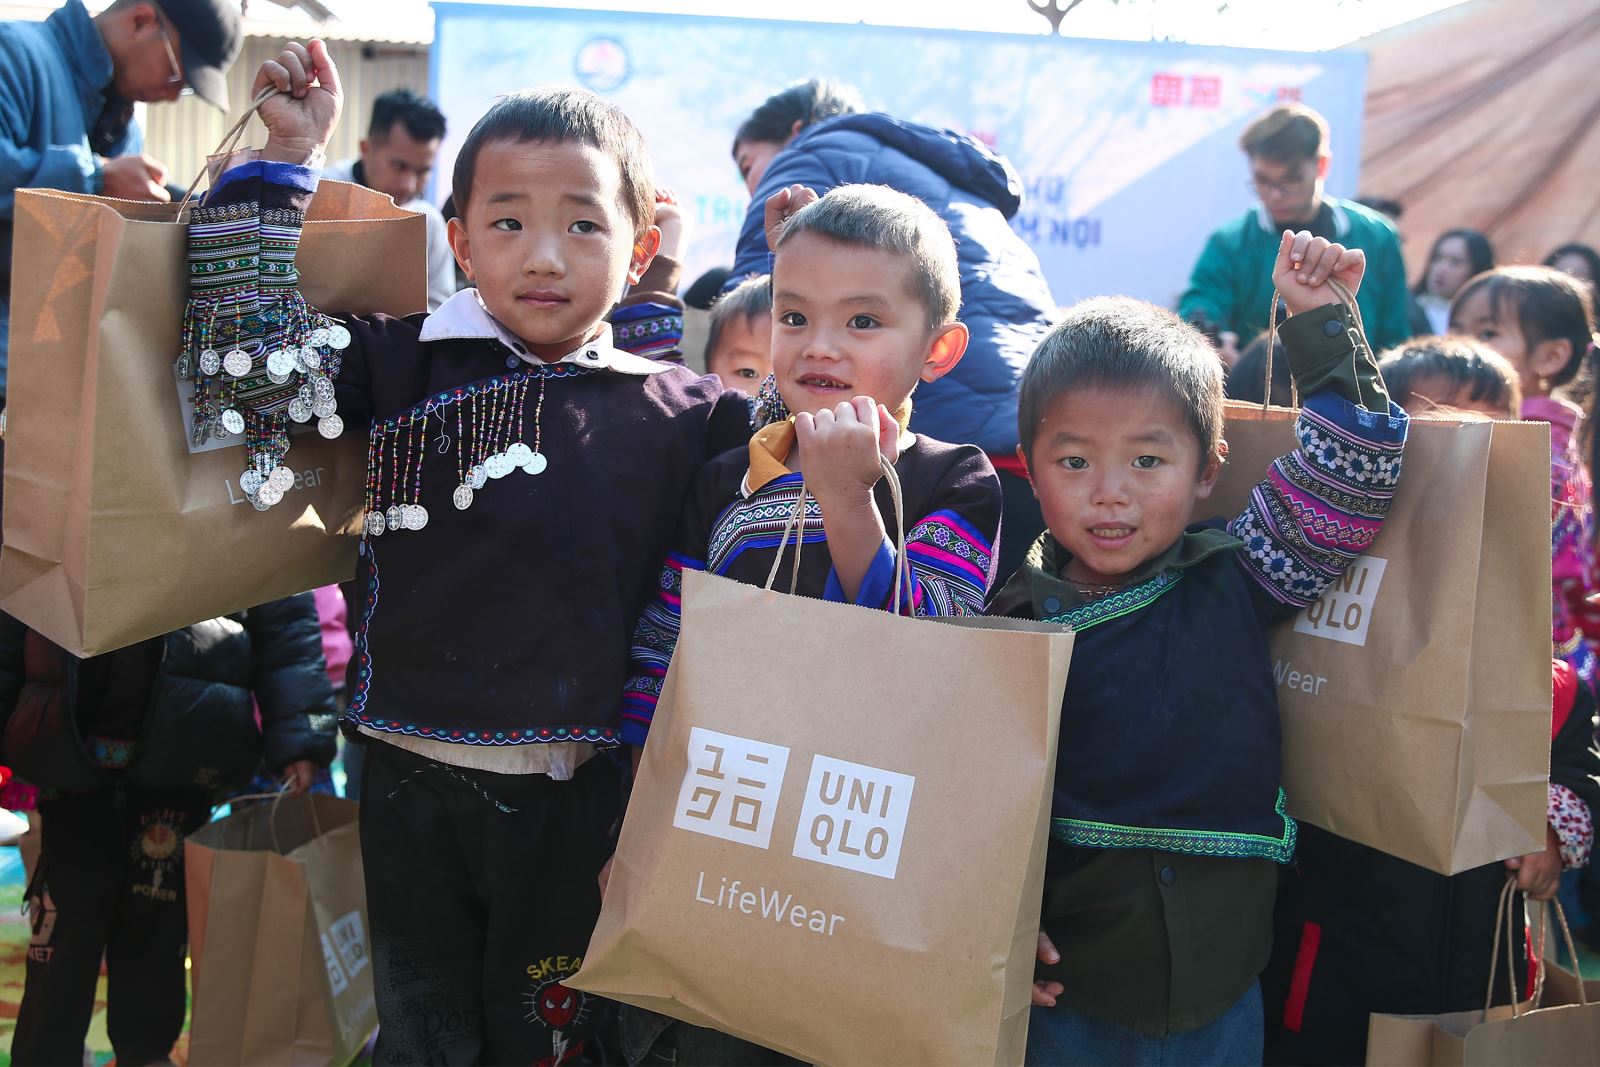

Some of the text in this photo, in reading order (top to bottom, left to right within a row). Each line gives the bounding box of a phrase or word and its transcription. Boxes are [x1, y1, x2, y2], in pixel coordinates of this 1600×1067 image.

[1335, 566, 1369, 596] NI
[1306, 597, 1363, 632] QLO
[819, 771, 893, 818] UNI
[809, 814, 889, 860] QLO
[695, 872, 845, 936] LifeWear
[527, 956, 584, 980] SKEA
